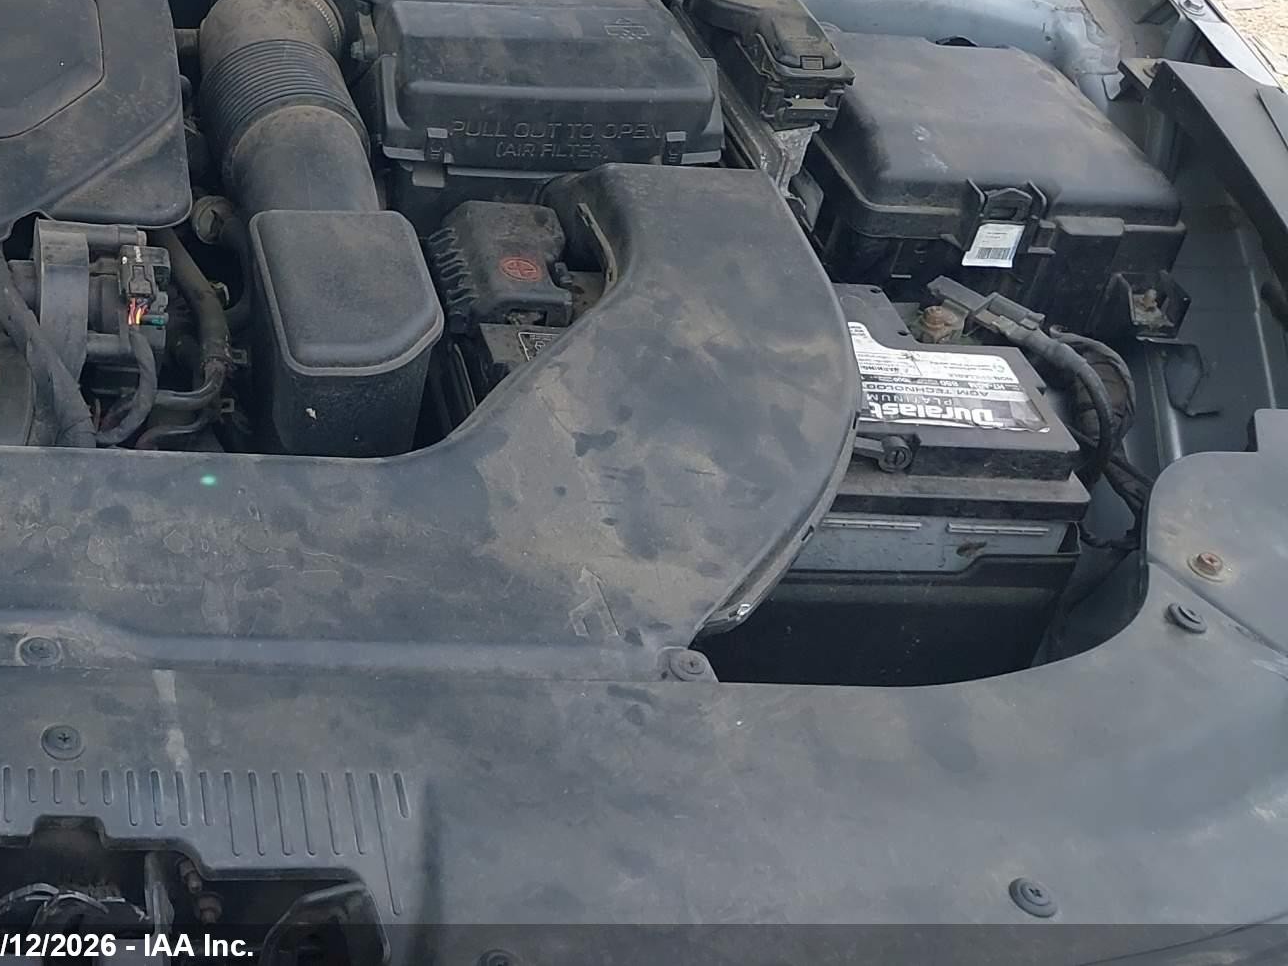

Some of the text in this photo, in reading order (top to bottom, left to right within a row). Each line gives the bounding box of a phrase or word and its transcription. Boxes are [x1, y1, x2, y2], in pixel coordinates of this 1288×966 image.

[449, 120, 662, 139] PULL OUT TO OPEN
[496, 141, 536, 158] (AIR
[863, 383, 954, 396] TECHNOLOG
[866, 393, 953, 406] PLATINUM
[868, 402, 1003, 427] Duralast
